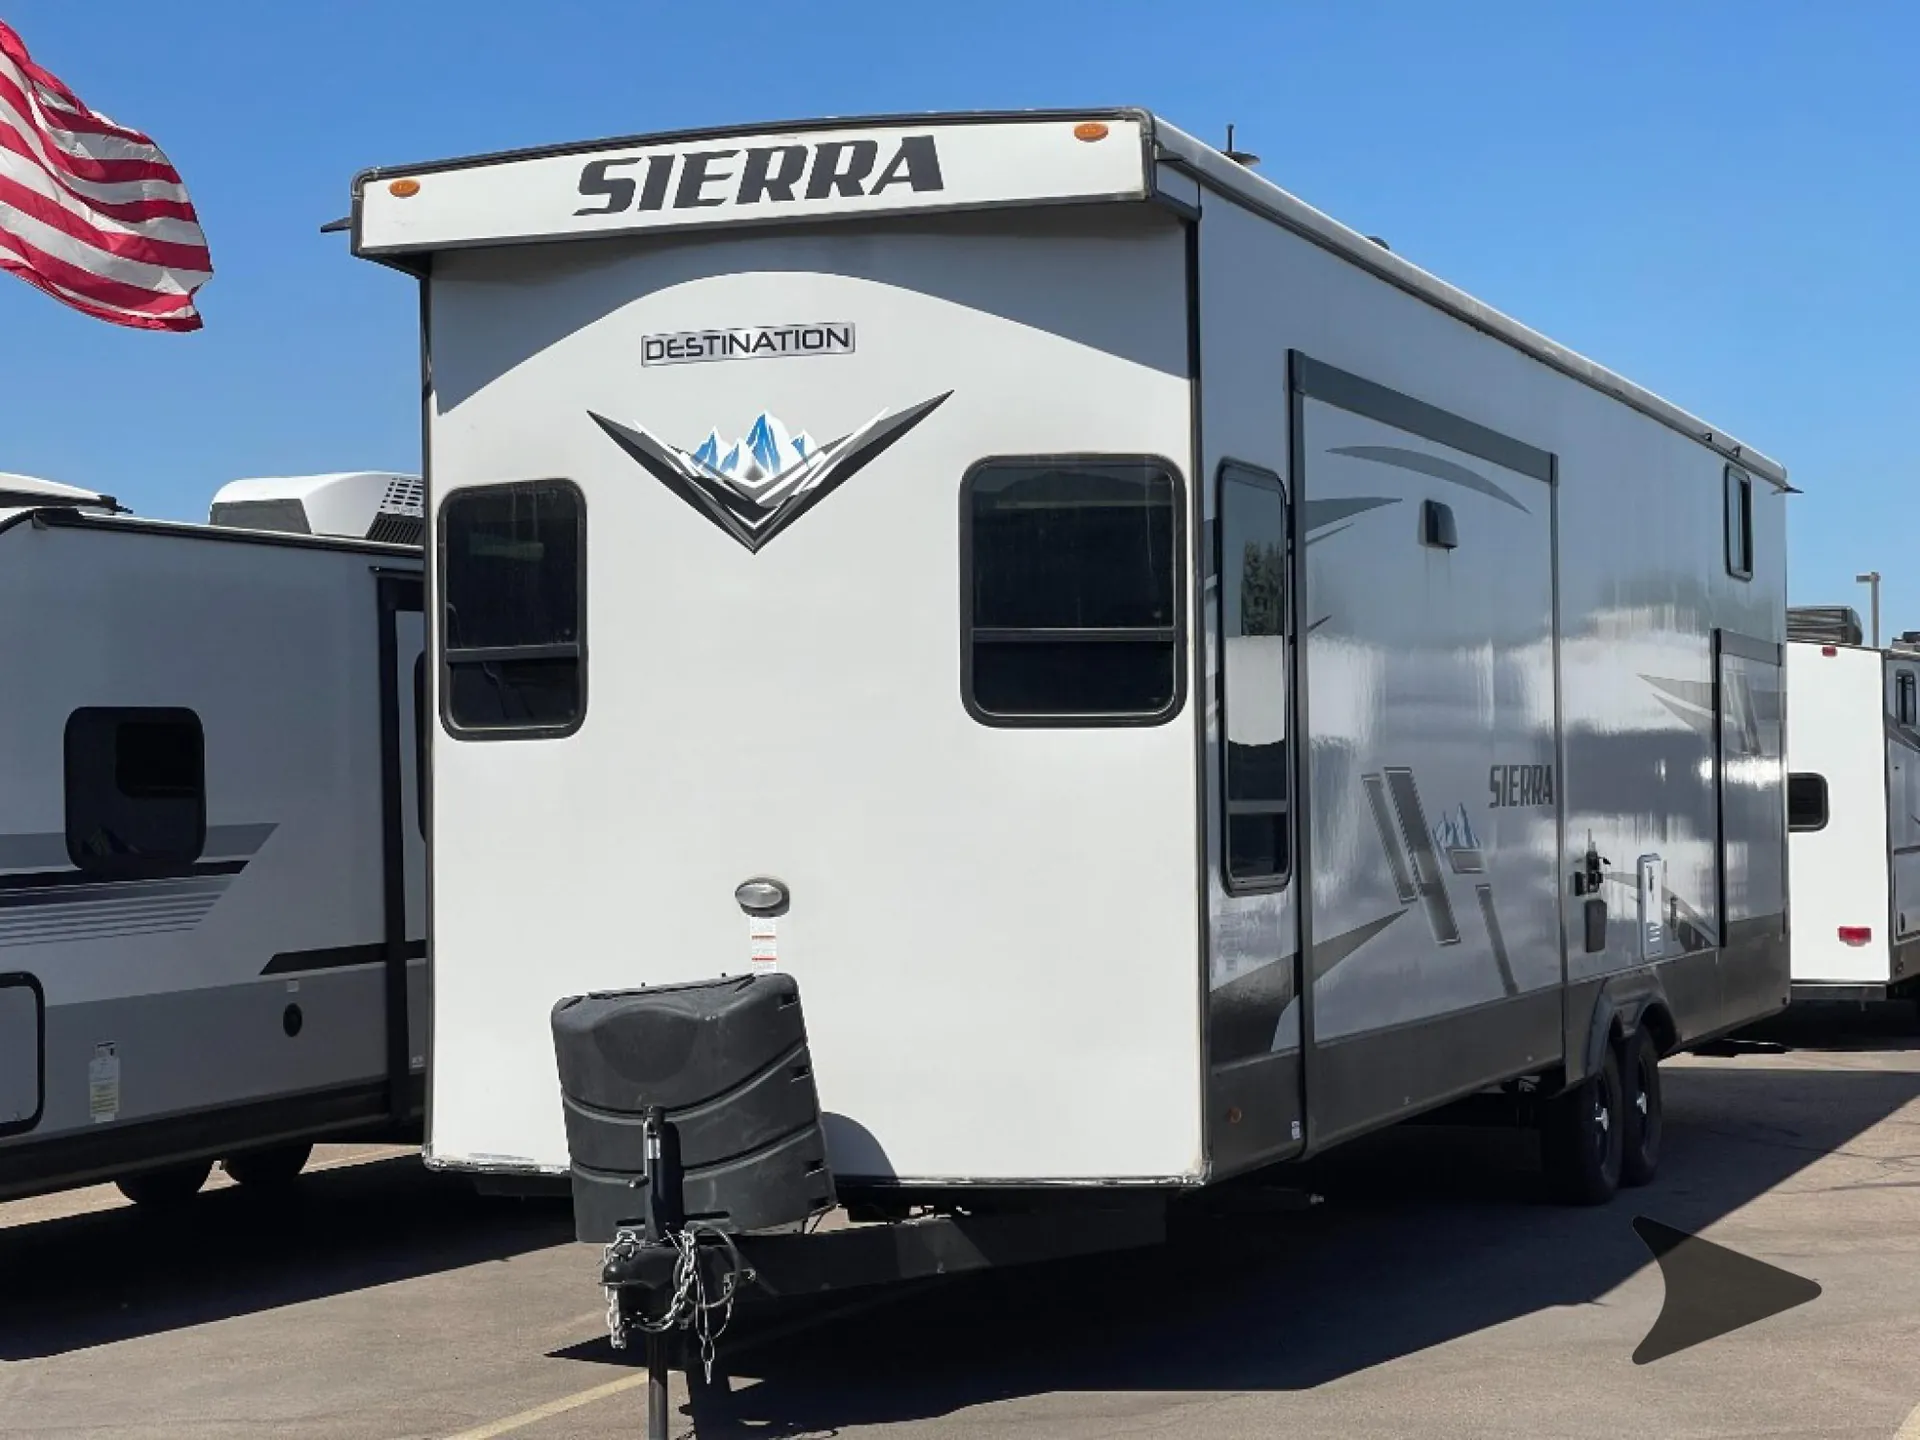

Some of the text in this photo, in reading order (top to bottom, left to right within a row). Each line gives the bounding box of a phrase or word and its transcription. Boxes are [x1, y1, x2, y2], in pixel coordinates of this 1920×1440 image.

[572, 135, 944, 215] SIERRA
[646, 328, 849, 361] DESTINATION
[1489, 764, 1553, 808] SIERRA
